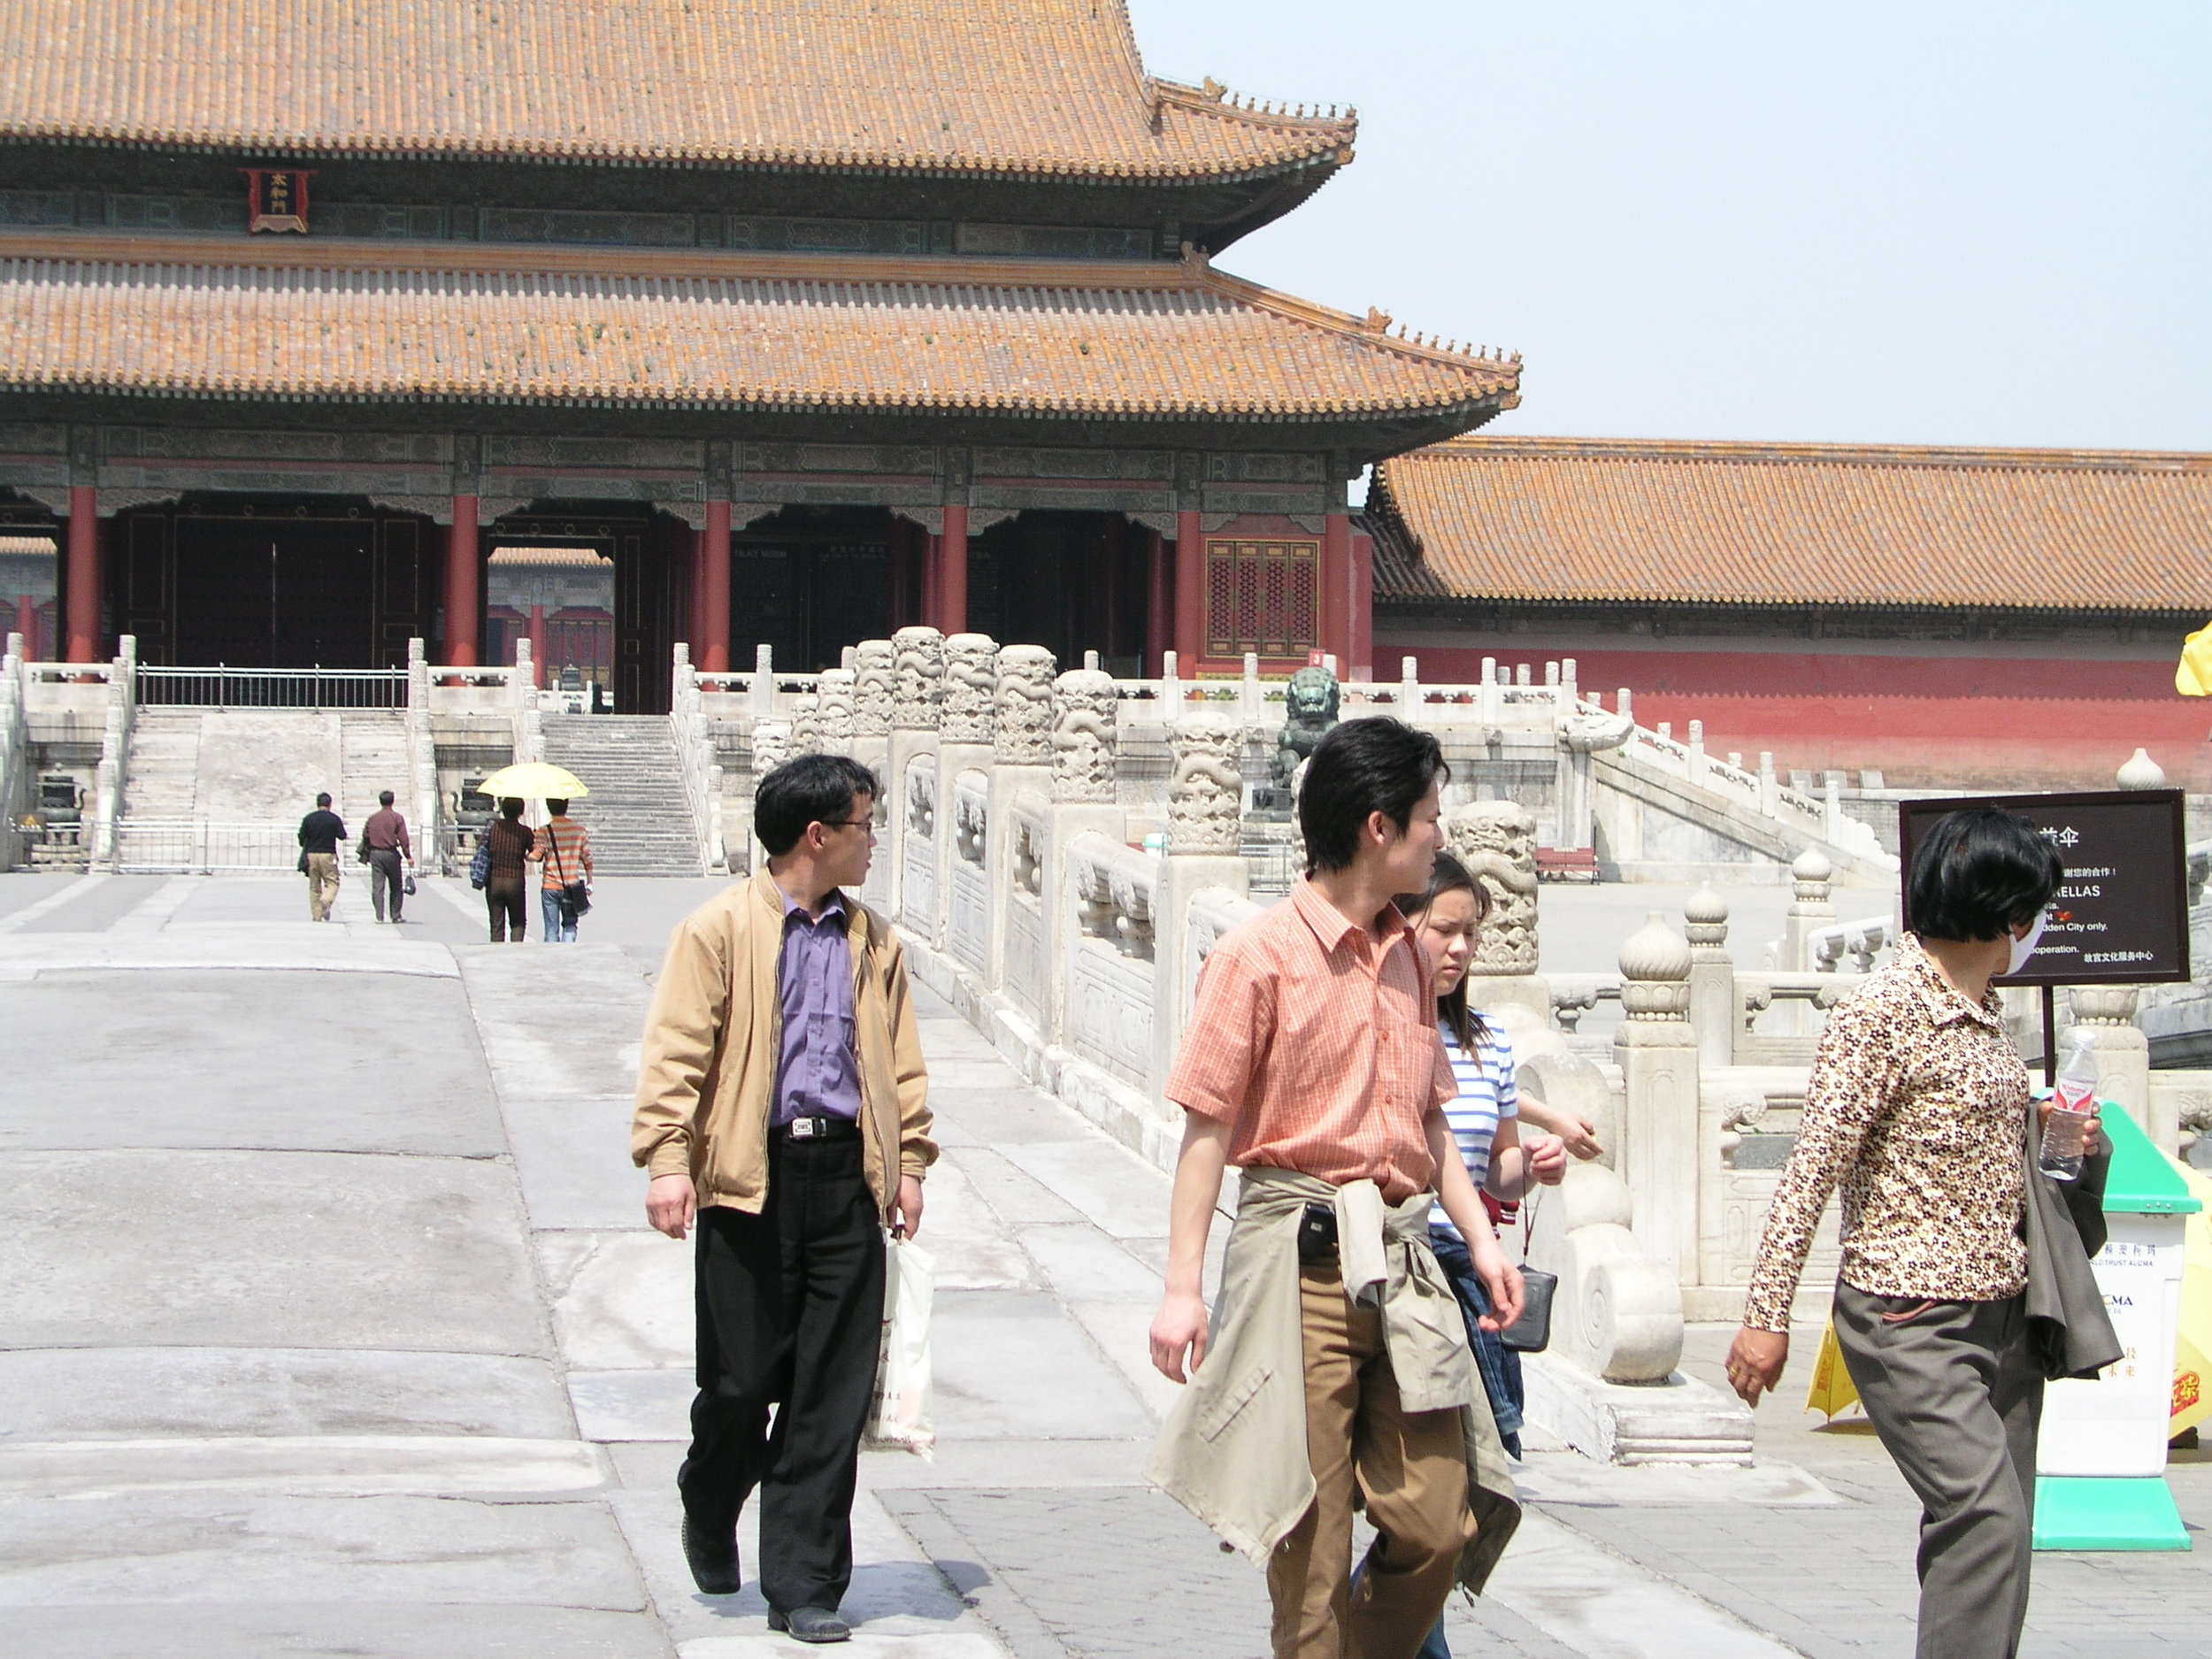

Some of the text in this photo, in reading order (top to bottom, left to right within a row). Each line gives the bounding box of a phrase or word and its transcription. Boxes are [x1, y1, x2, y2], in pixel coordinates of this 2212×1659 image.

[1313, 654, 1320, 664] 3
[2042, 922, 2108, 933] dden City only.
[2102, 1294, 2133, 1306] CMA
[2125, 1347, 2136, 1359] 技
